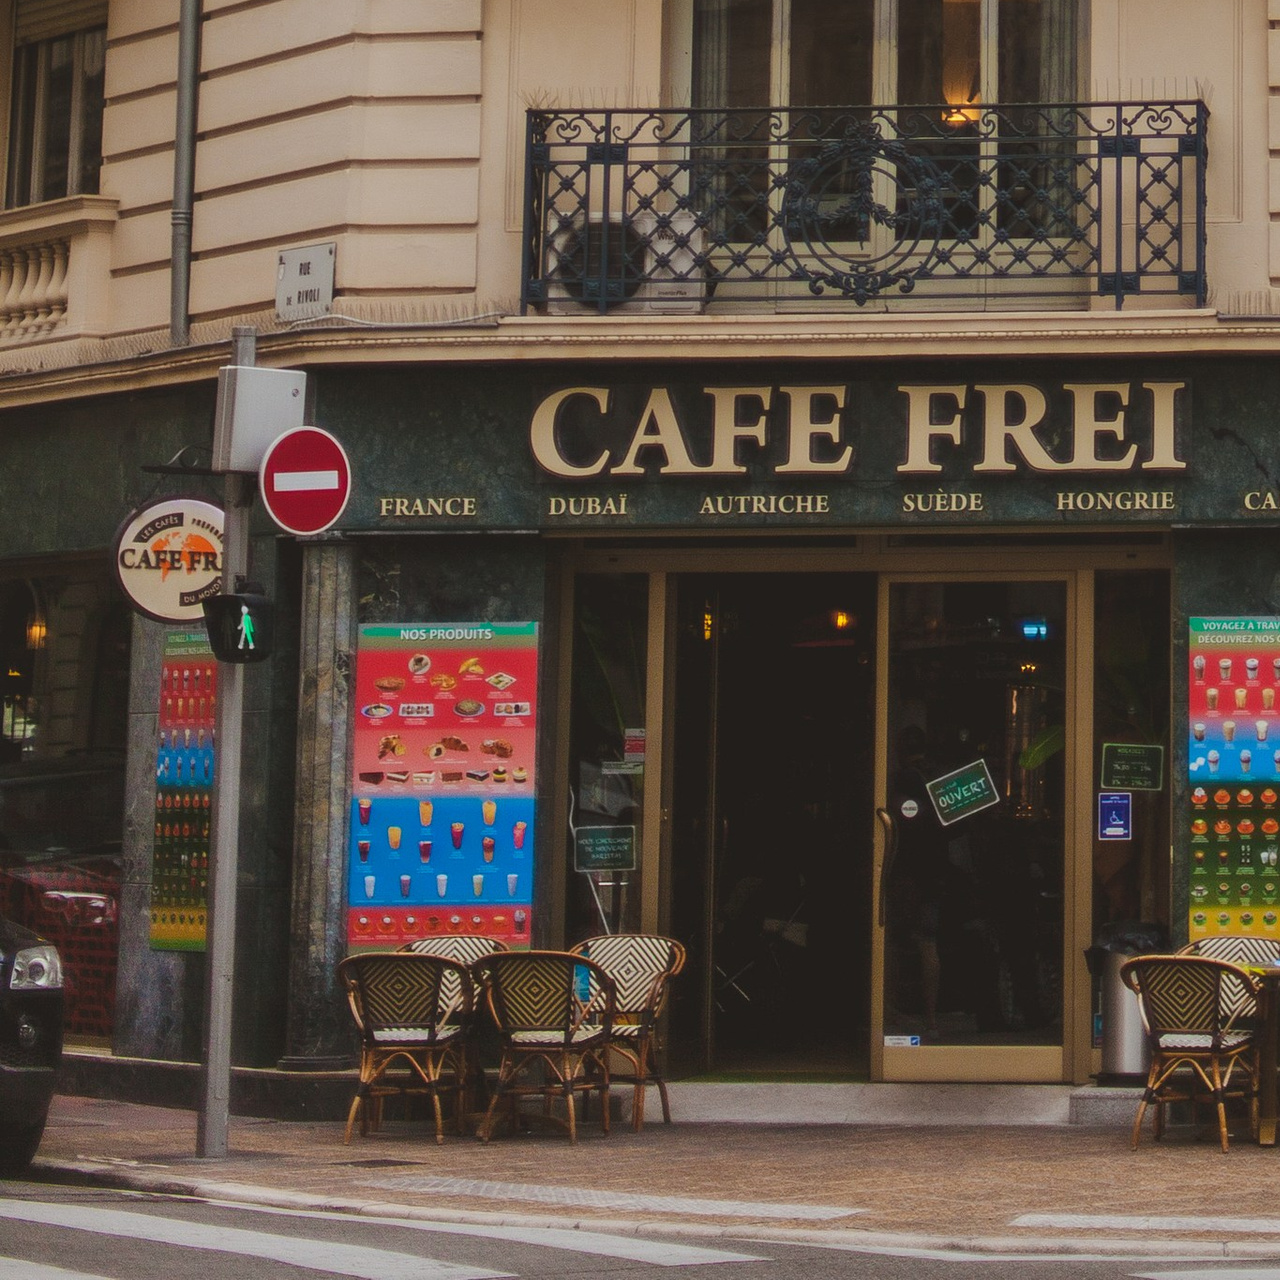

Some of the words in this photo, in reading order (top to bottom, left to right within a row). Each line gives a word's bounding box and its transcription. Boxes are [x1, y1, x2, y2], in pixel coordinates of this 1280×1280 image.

[299, 261, 311, 276] RUE
[297, 288, 320, 304] RIVOLI
[530, 385, 853, 477] CAFE
[897, 382, 1187, 472] FREI
[380, 497, 476, 517] FRANCE
[549, 493, 628, 516] DUBAÏ
[699, 495, 829, 515] AUTRICHE
[902, 488, 983, 513] SUÈDE
[1057, 491, 1175, 511] HONGRIE
[141, 527, 154, 539] LES
[120, 548, 183, 570] CAFE
[400, 629, 427, 640] NOS
[430, 628, 492, 640] PRODUITS
[1203, 622, 1245, 630] VOYAGEZ
[1198, 633, 1254, 643] DÉCOUVREZ
[1255, 634, 1275, 643] NOS
[939, 777, 985, 808] OUVERT
